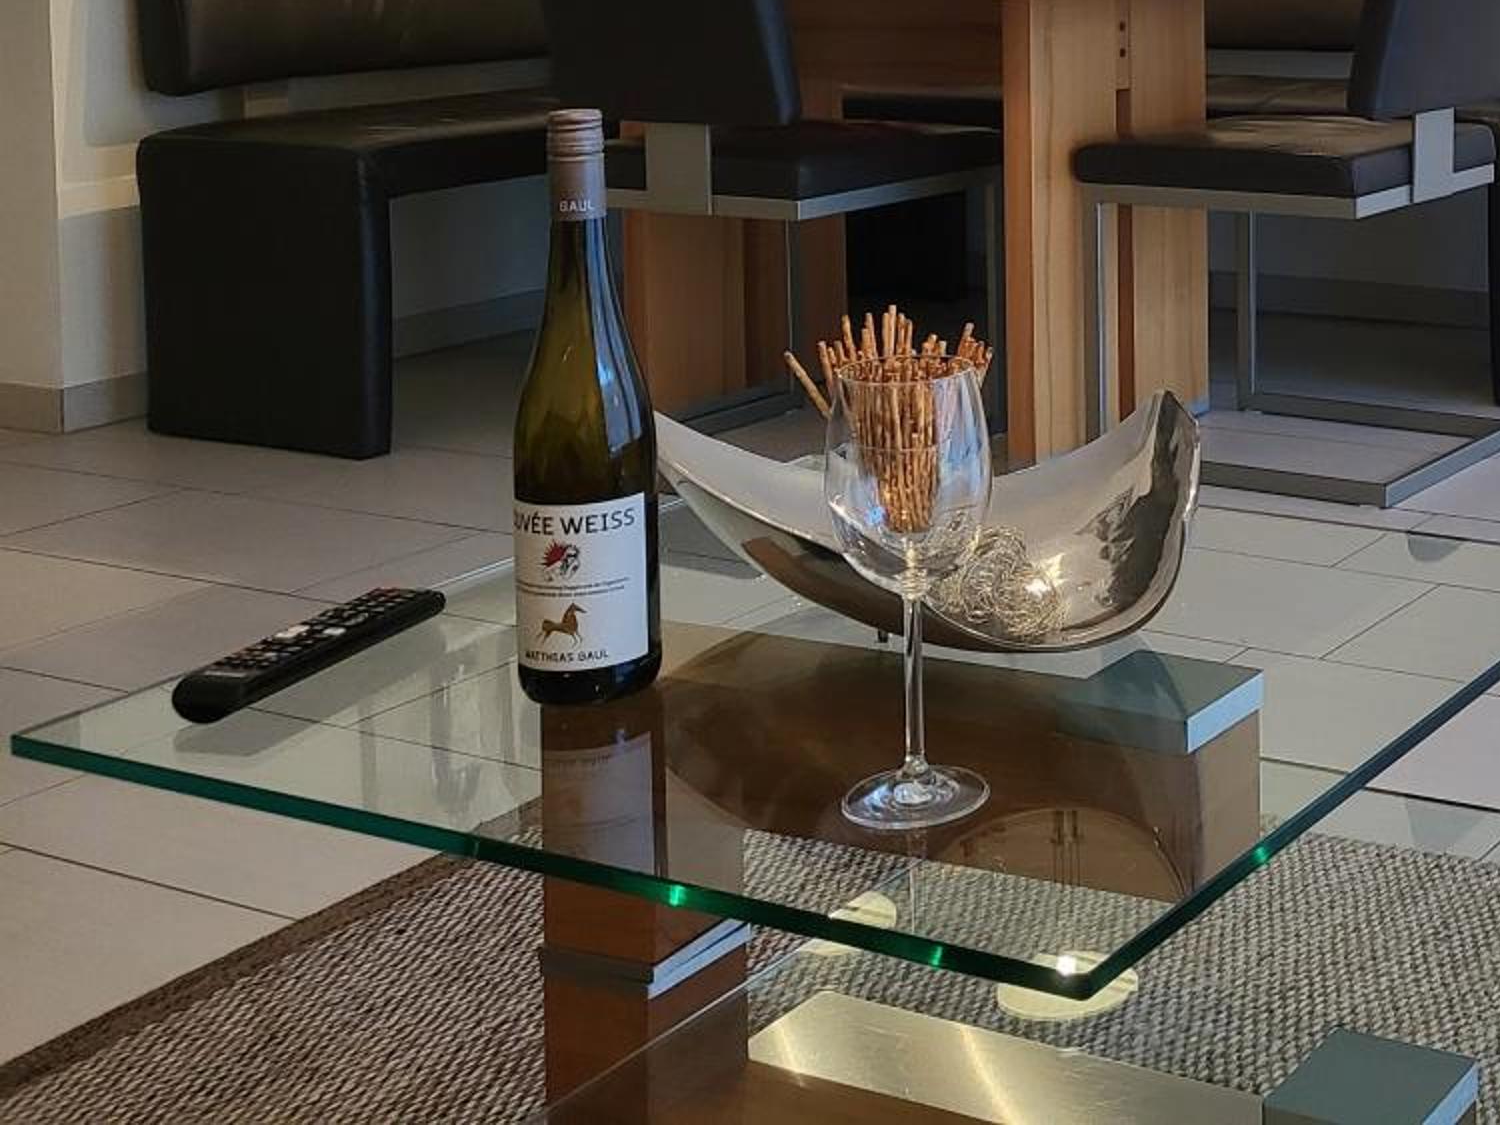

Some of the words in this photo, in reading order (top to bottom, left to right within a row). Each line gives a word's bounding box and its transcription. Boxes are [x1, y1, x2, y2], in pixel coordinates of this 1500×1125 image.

[559, 199, 597, 212] GAUL
[514, 509, 555, 536] UVÉE
[560, 507, 636, 535] WEISS
[577, 649, 609, 662] GAUL
